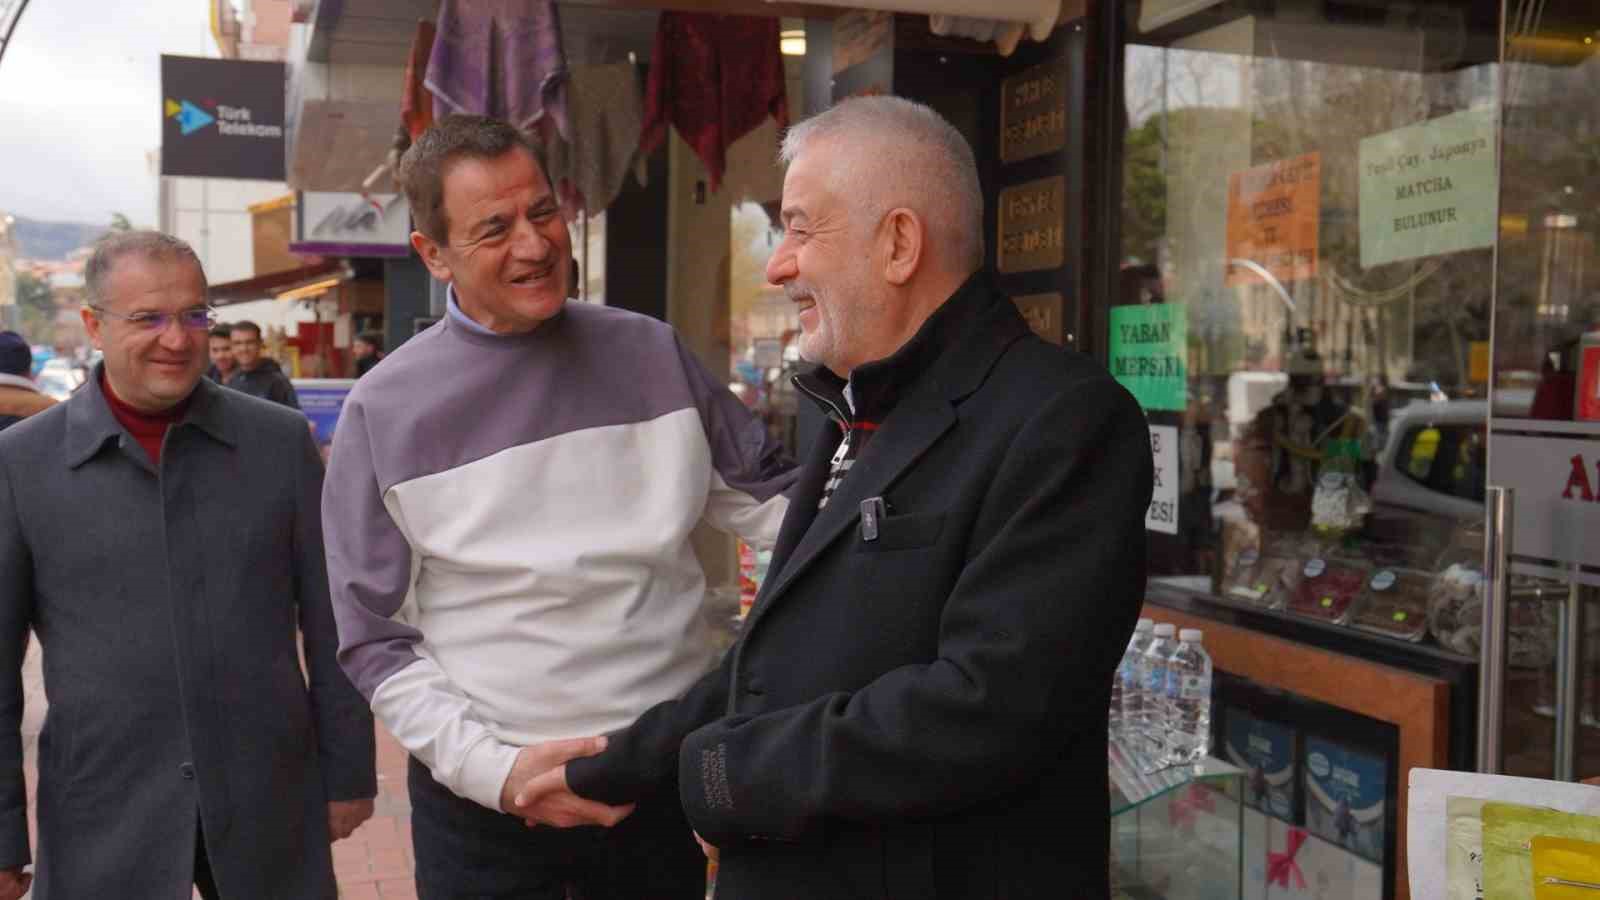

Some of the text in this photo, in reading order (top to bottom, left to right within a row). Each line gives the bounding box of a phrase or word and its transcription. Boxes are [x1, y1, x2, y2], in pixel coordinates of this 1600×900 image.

[216, 104, 251, 120] Türk
[216, 121, 281, 137] Telekom
[1395, 176, 1453, 200] MATCHA
[1393, 207, 1457, 232] BULUNUR
[1119, 322, 1170, 344] YABAN
[1152, 433, 1161, 453] E
